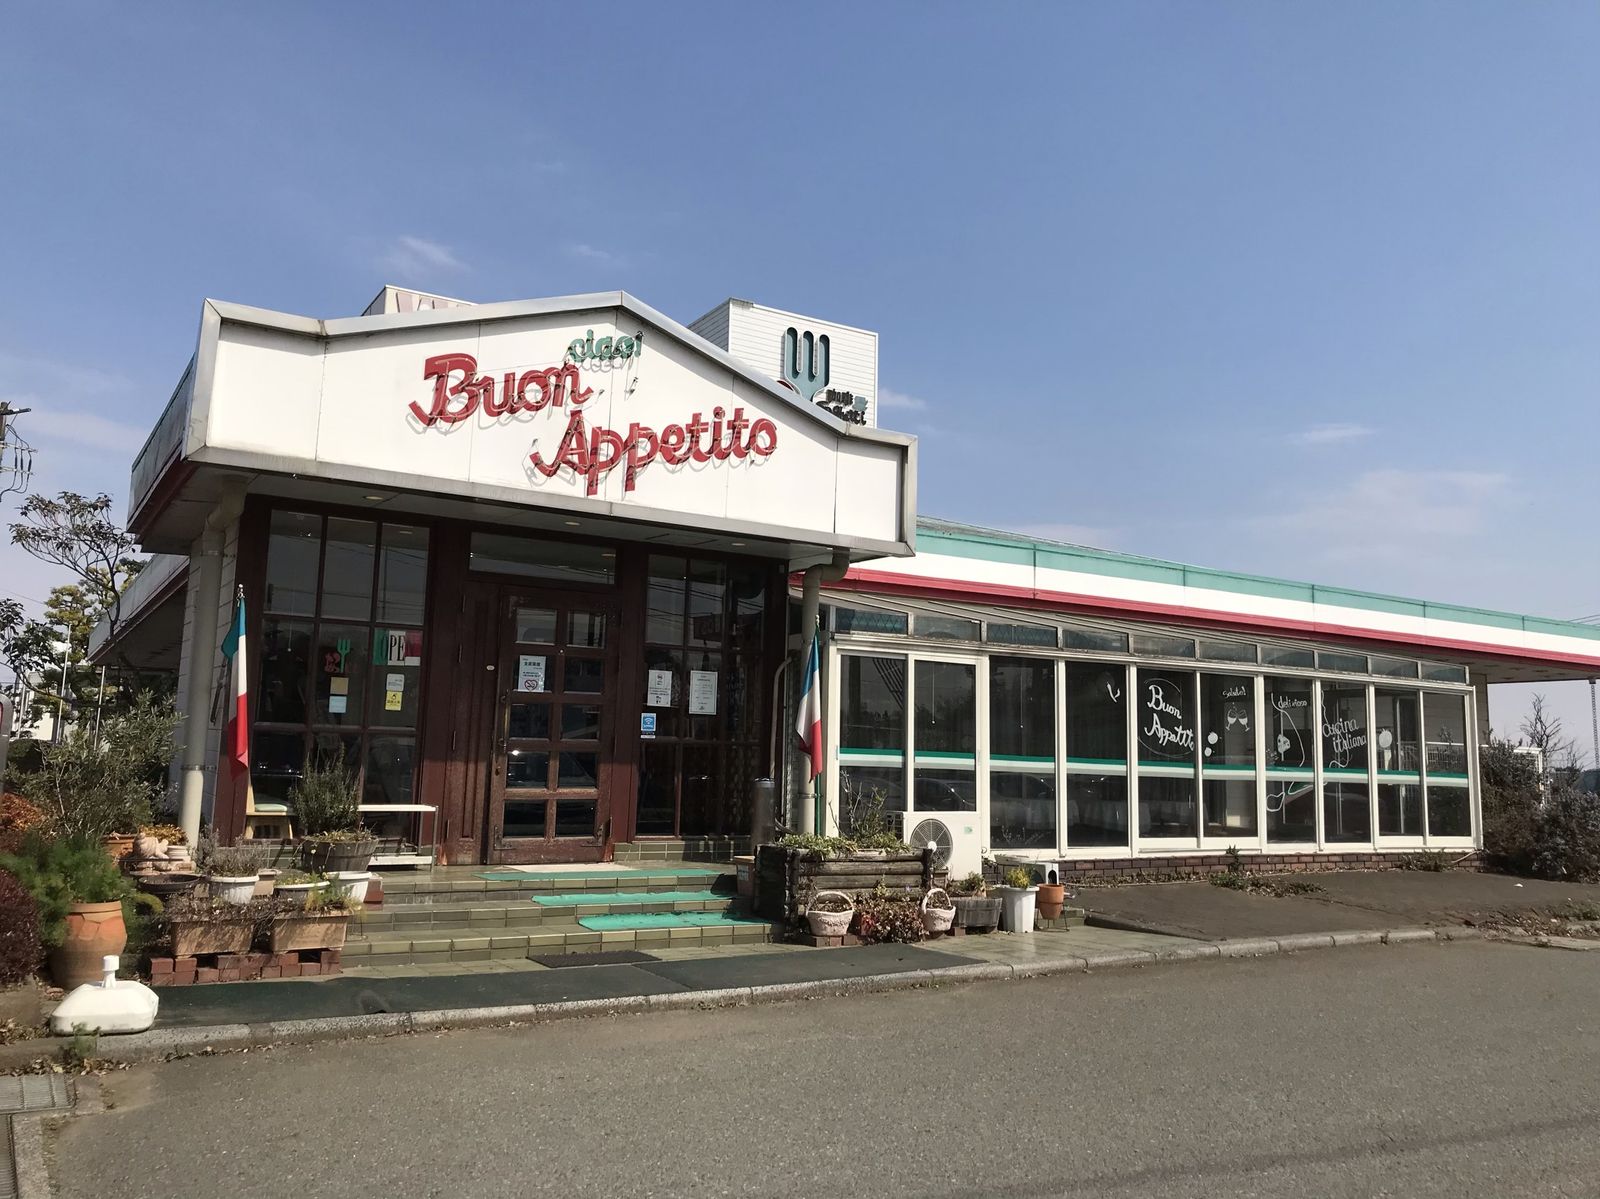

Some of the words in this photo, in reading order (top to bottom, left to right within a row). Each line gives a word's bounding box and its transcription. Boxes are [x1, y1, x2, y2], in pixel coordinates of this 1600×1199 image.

[408, 353, 594, 426] Buon
[530, 408, 777, 496] Appetito
[1147, 684, 1182, 719] Buon
